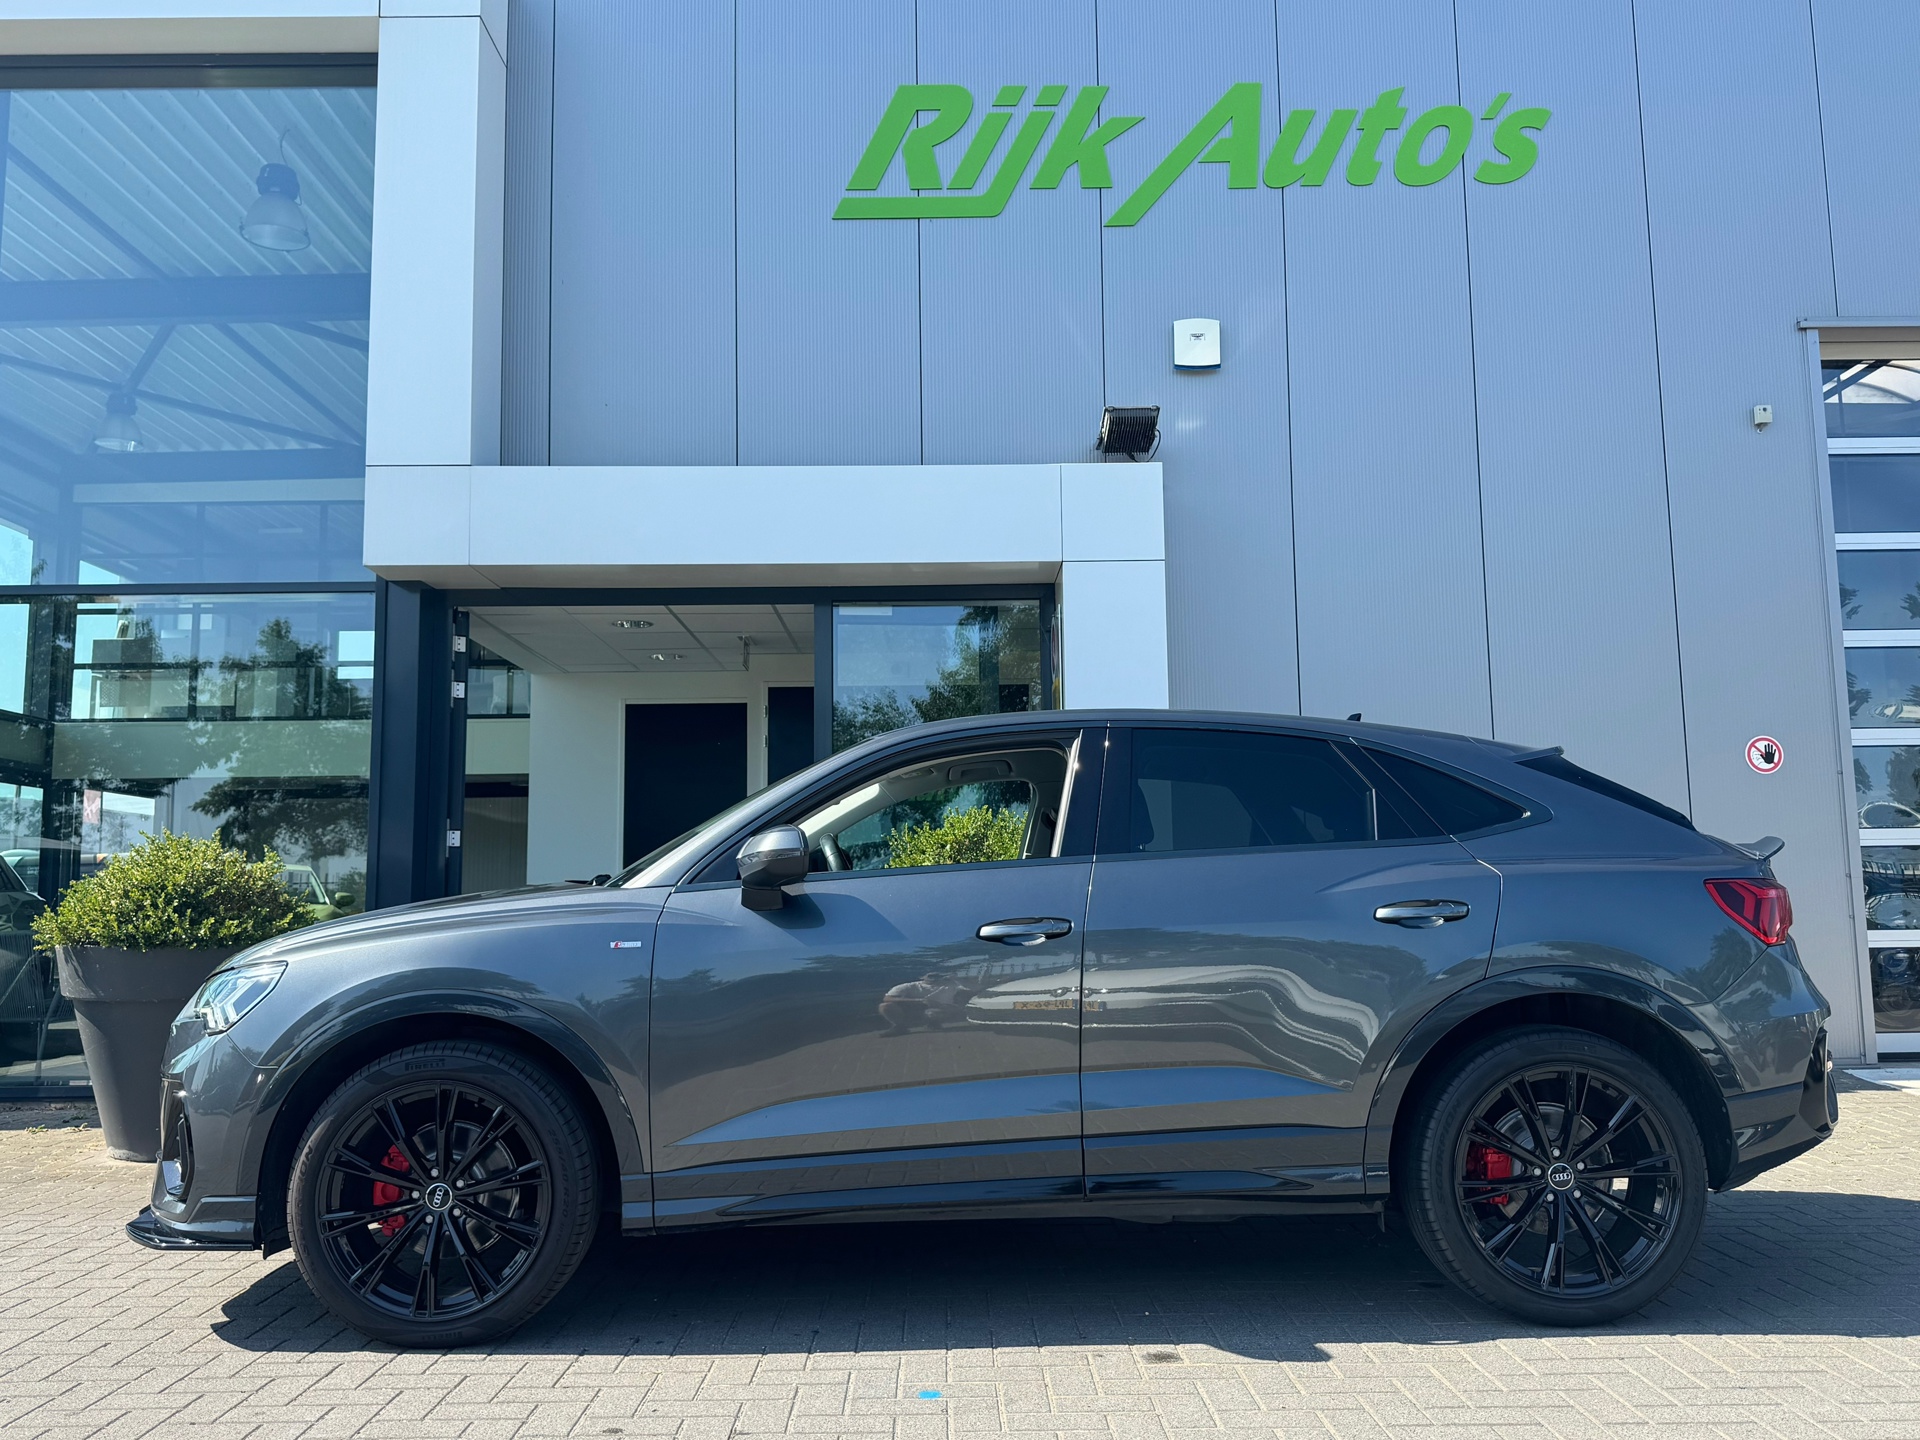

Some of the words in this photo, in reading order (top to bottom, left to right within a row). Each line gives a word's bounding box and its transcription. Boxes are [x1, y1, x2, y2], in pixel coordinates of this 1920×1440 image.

[832, 84, 1145, 220] Rijk
[1103, 82, 1552, 228] Auto's
[404, 1058, 446, 1072] PIRELLI
